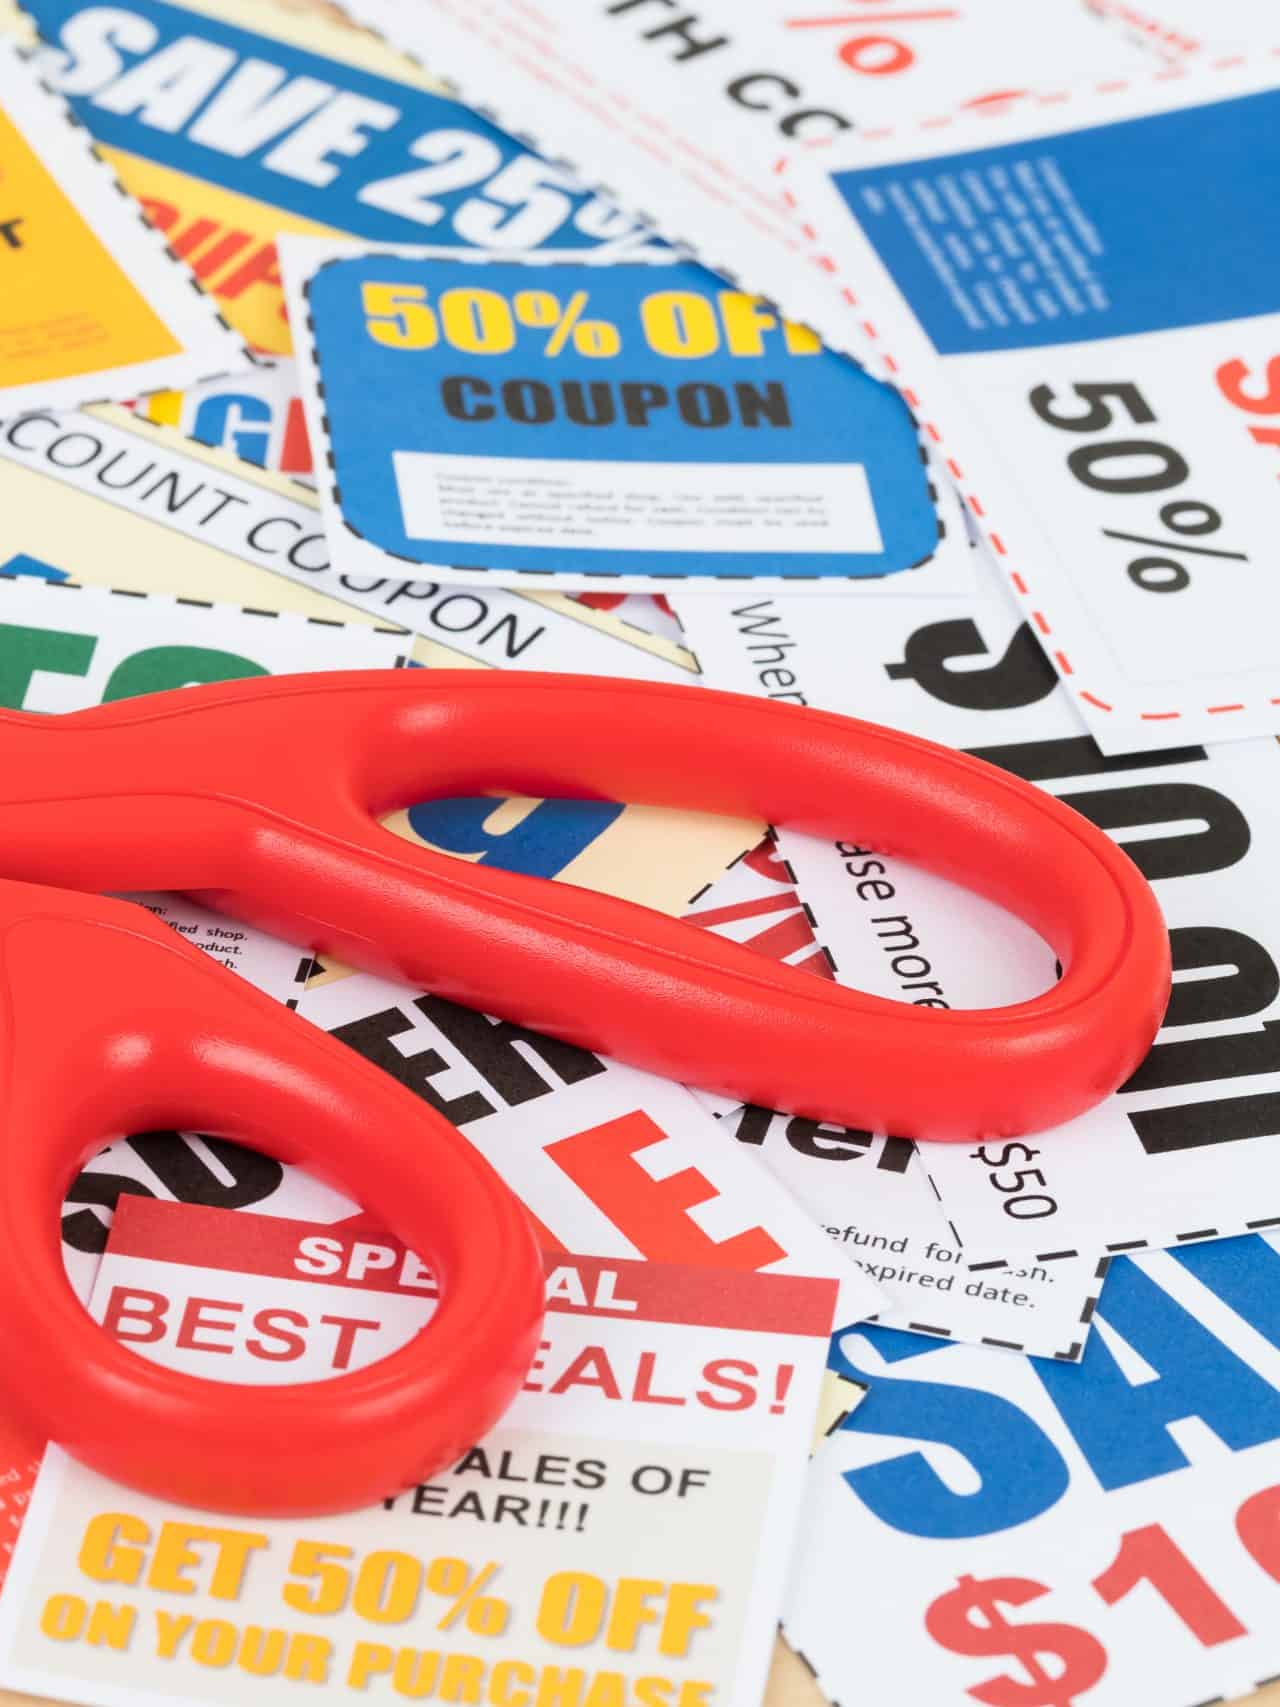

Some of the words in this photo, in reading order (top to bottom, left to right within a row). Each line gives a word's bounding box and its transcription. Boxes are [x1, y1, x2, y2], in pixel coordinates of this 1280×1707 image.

[37, 6, 401, 188] SAVE
[361, 282, 622, 358] 50%
[440, 376, 793, 428] COUPON
[1029, 381, 1249, 594] 50%
[969, 1141, 1058, 1220] $50
[103, 1285, 380, 1370] BEST
[965, 1281, 1037, 1310] date.
[631, 1465, 711, 1498] OF
[77, 1511, 270, 1603] GET
[282, 1538, 509, 1638] 50%
[535, 1570, 719, 1659] OFF
[40, 1593, 137, 1651] ON
[155, 1607, 335, 1686] YOUR
